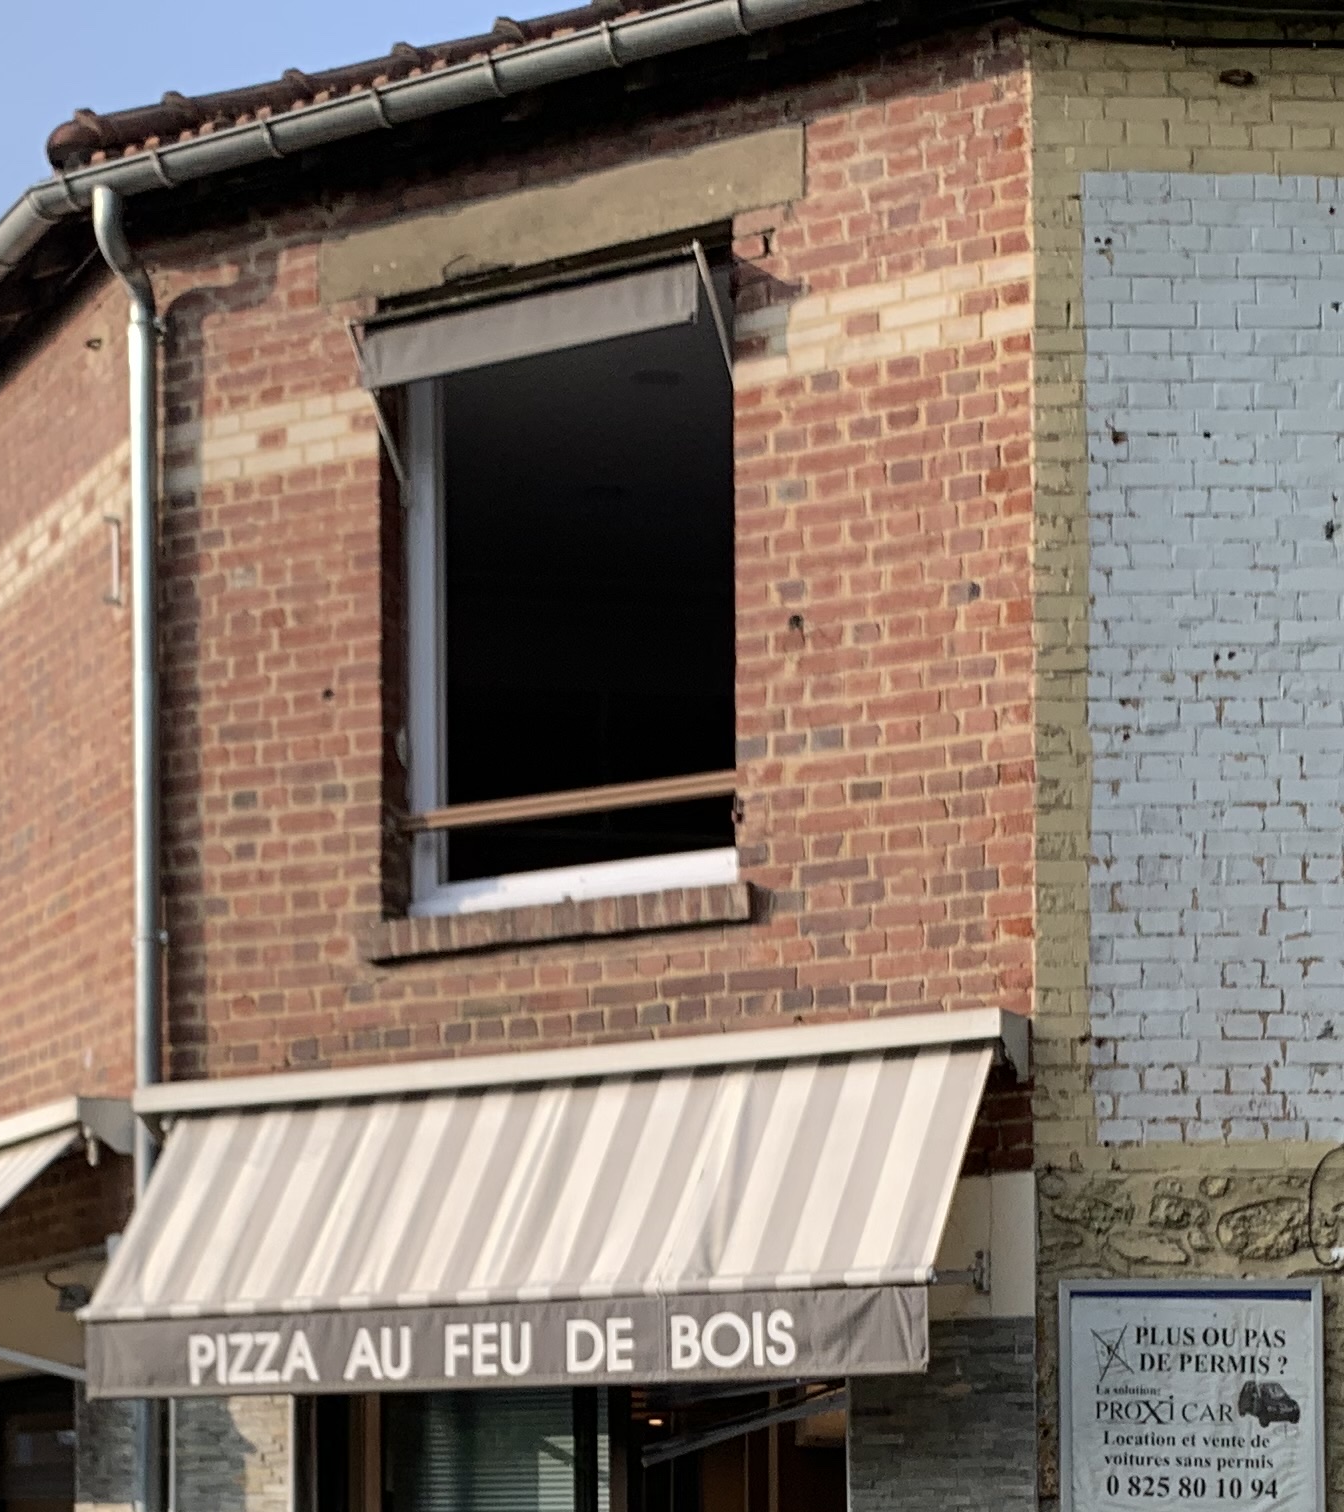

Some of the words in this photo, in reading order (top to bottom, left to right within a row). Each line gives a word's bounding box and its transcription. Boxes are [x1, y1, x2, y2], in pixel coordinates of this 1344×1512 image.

[188, 1328, 320, 1387] PIZZA
[344, 1324, 411, 1382] AU
[445, 1321, 533, 1378] FEU
[566, 1316, 635, 1374] DE
[670, 1309, 798, 1370] BOIS
[1135, 1325, 1195, 1346] PLUS
[1201, 1327, 1236, 1348] OU
[1244, 1328, 1287, 1349] PAS
[1140, 1352, 1172, 1373] DE
[1179, 1353, 1270, 1376] PERMIS
[1277, 1356, 1288, 1376] ?
[1096, 1384, 1111, 1396] La
[1181, 1402, 1234, 1423] CAR
[1104, 1430, 1176, 1447] Location
[1181, 1433, 1196, 1447] et
[1203, 1434, 1246, 1449] vente
[1250, 1434, 1271, 1449] de
[1104, 1452, 1171, 1468] voitures
[1175, 1455, 1212, 1469] sans
[1216, 1455, 1274, 1473] permis
[1107, 1474, 1120, 1497] 0
[1127, 1475, 1171, 1498] 825
[1178, 1476, 1207, 1499] 80
[1217, 1477, 1243, 1500] 10
[1250, 1478, 1278, 1501] 94
